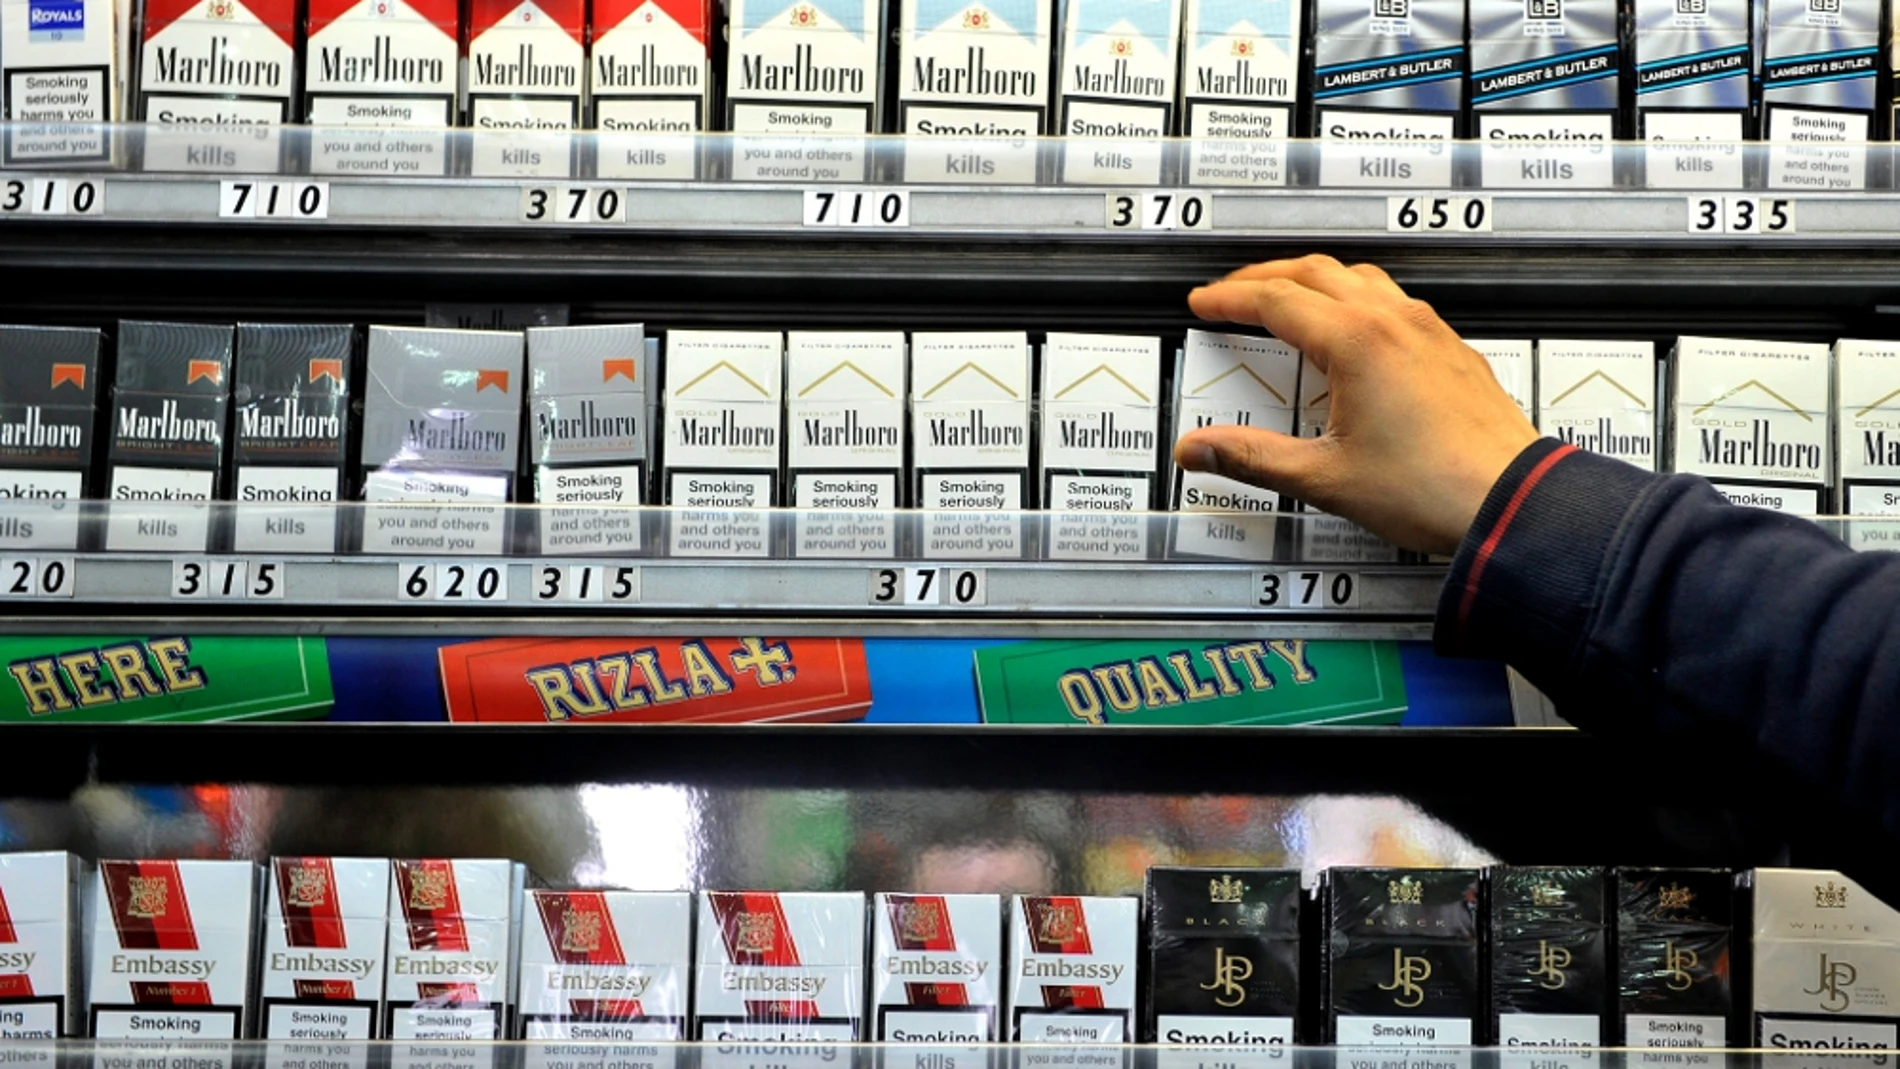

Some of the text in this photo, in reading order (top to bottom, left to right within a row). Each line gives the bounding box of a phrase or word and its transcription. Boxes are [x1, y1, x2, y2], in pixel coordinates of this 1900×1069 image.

[32, 9, 82, 22] ROYALS
[154, 37, 280, 88] Marlboro
[319, 36, 443, 84] Marlboro
[474, 44, 576, 88] Marlboro
[597, 44, 698, 88] Marlboro
[1771, 64, 1821, 79] LAMBERT
[1830, 57, 1872, 70] BUTLER
[740, 44, 863, 94] Marlboro
[912, 46, 1036, 97] Marlboro
[1073, 58, 1164, 96] Marlboro
[1324, 59, 1452, 87] LAMBERT & BUTLER
[1481, 57, 1607, 92] LAMBERT & BUTLER
[1641, 66, 1691, 83] LAMBERT
[1700, 56, 1742, 72] BUTLER
[26, 77, 88, 90] Smoking
[1196, 60, 1287, 97] Marlboro
[26, 92, 89, 106] seriously
[20, 109, 94, 121] harms you
[347, 105, 412, 120] Smoking
[768, 112, 832, 127] Smoking
[1208, 111, 1272, 128] Smoking
[1792, 116, 1846, 131] Smoking
[17, 140, 97, 153] around you
[323, 139, 433, 154] you and others
[775, 148, 853, 161] and others
[187, 146, 237, 166] kills
[502, 149, 541, 165] kills
[627, 149, 666, 165] kills
[1093, 152, 1132, 169] kills
[1200, 153, 1277, 167] and others
[337, 158, 419, 172] around you
[757, 165, 839, 180] around you
[946, 154, 995, 175] kills
[1360, 158, 1412, 178] kills
[1521, 159, 1574, 179] kills
[1675, 157, 1714, 172] kills
[1811, 161, 1849, 173] others
[1197, 167, 1278, 181] around you
[1782, 174, 1825, 185] around
[2, 180, 95, 212] 310
[232, 184, 320, 215] 710
[526, 189, 618, 220] 370
[816, 193, 901, 223] 710
[1113, 196, 1202, 227] 370
[1398, 197, 1485, 229] 650
[1696, 200, 1788, 230] 335
[0, 406, 81, 447] arlboro
[117, 400, 216, 442] Marlboro
[241, 398, 339, 439] Marlboro
[539, 401, 635, 439] Marlboro
[1692, 418, 1747, 427] GOLD
[409, 413, 505, 452] Marlboro
[680, 410, 775, 447] Marlboro
[803, 410, 898, 447] Marlboro
[929, 409, 1023, 447] Marlboro
[1059, 412, 1153, 450] Marlboro
[1699, 419, 1820, 469] Marlboro
[1760, 469, 1819, 479] ORIGINAL
[556, 475, 622, 490] Smoking
[689, 479, 754, 495] Smoking
[813, 479, 878, 495] Smoking
[939, 479, 1004, 495] Smoking
[1067, 482, 1133, 498] Smoking
[556, 489, 623, 503] seriously
[939, 495, 1006, 509] seriously
[138, 520, 177, 536] kills
[266, 518, 305, 534] kills
[378, 516, 489, 531] you and others
[551, 518, 630, 531] and others
[680, 524, 760, 536] and others
[806, 524, 885, 536] and others
[933, 524, 1011, 536] and others
[549, 532, 633, 545] around you
[1059, 525, 1139, 539] and others
[1206, 522, 1246, 543] kills
[391, 536, 474, 549] around you
[678, 538, 762, 552] around you
[804, 538, 887, 551] around you
[931, 538, 1014, 551] around you
[1057, 540, 1140, 554] around you
[179, 563, 275, 595] 315
[406, 566, 499, 598] 620
[539, 567, 634, 598] 315
[875, 569, 977, 603] 370
[1259, 573, 1353, 605] 370
[8, 637, 207, 716] HERE
[1059, 639, 1318, 725] QUALITY
[111, 955, 216, 980] Embassy
[271, 953, 375, 980] Embassy
[395, 956, 499, 982] Embassy
[888, 956, 988, 982] Embassy
[1022, 959, 1124, 984] Embassy
[549, 971, 651, 997] Embassy
[724, 972, 827, 998] Embassy
[130, 1017, 201, 1033] Smoking
[291, 1011, 347, 1025] Smoking
[417, 1015, 472, 1028] Smoking
[290, 1028, 347, 1040] seriously
[571, 1026, 633, 1041] Smoking
[1046, 1025, 1097, 1039] Smoking
[1372, 1024, 1436, 1039] Smoking
[1648, 1022, 1703, 1034] Smoking
[1770, 1033, 1888, 1065] Smoking
[915, 1054, 955, 1069] kills
[1078, 1055, 1115, 1067] others
